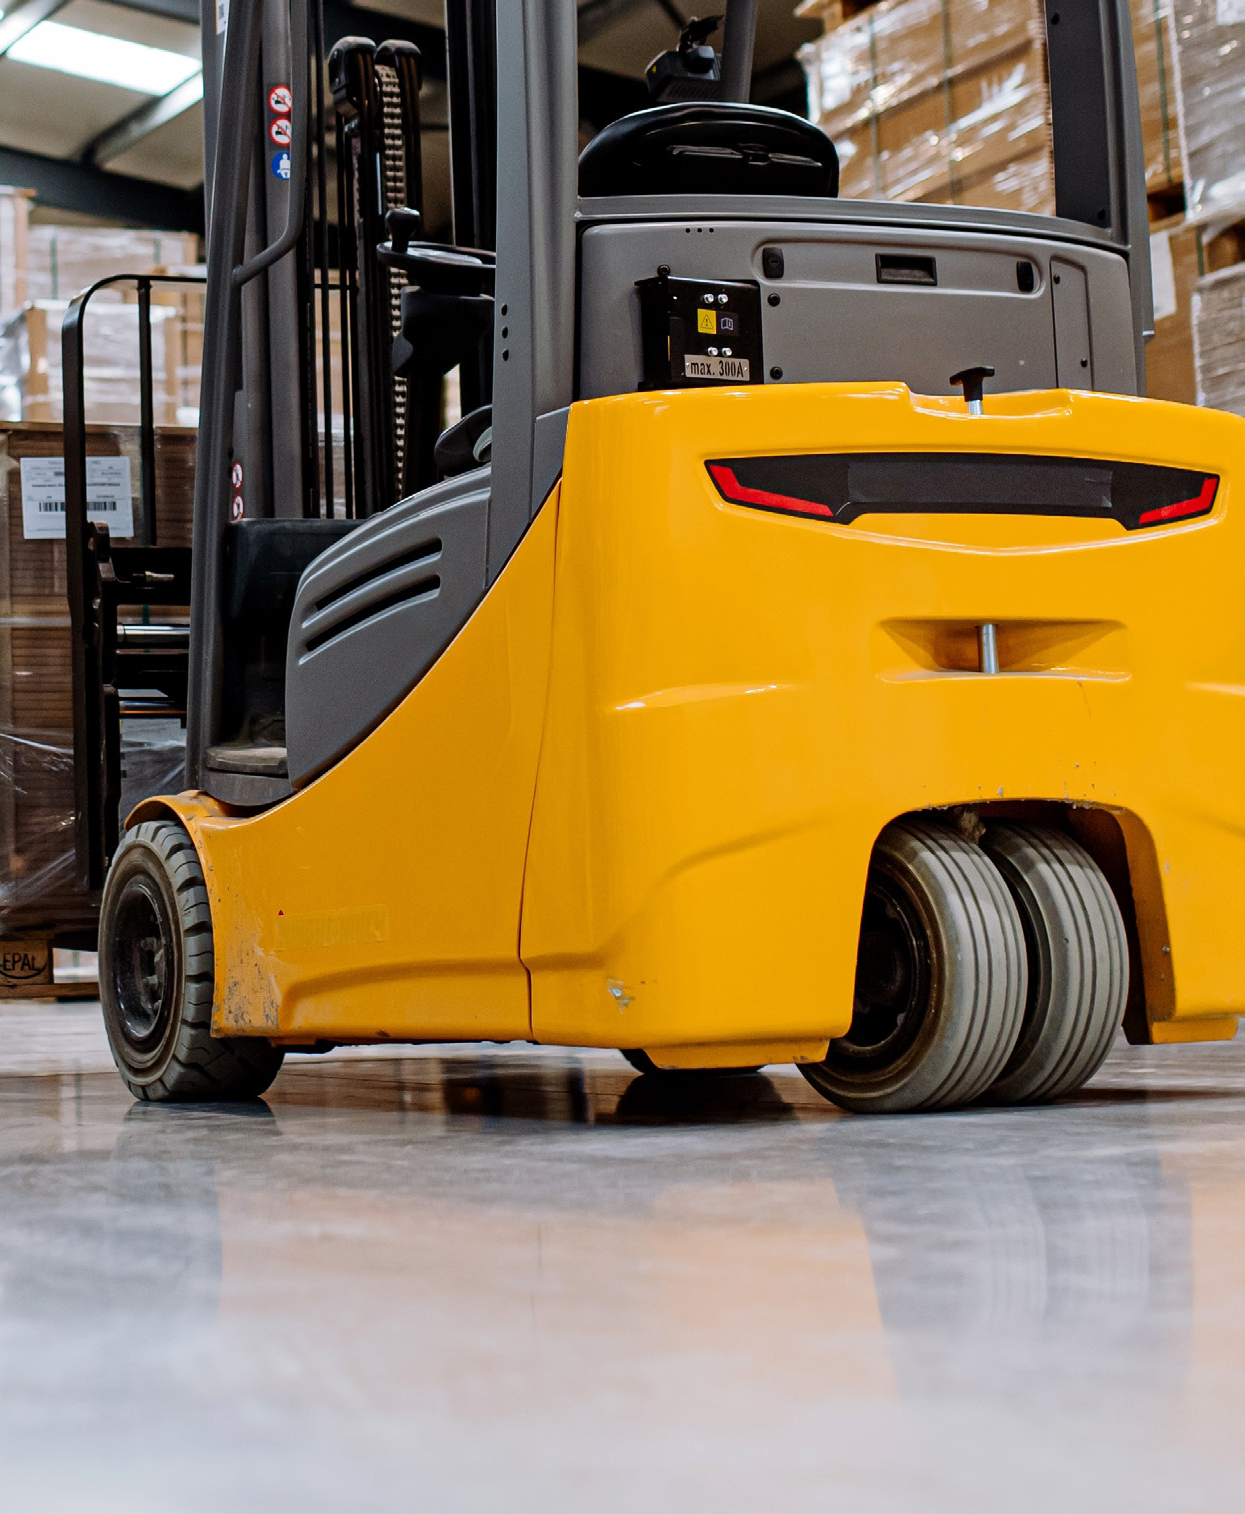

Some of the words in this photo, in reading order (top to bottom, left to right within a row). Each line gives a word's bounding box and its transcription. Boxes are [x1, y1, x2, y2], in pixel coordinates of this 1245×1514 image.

[690, 361, 715, 376] max.
[718, 360, 744, 378] 300A
[2, 951, 42, 972] EPAL
